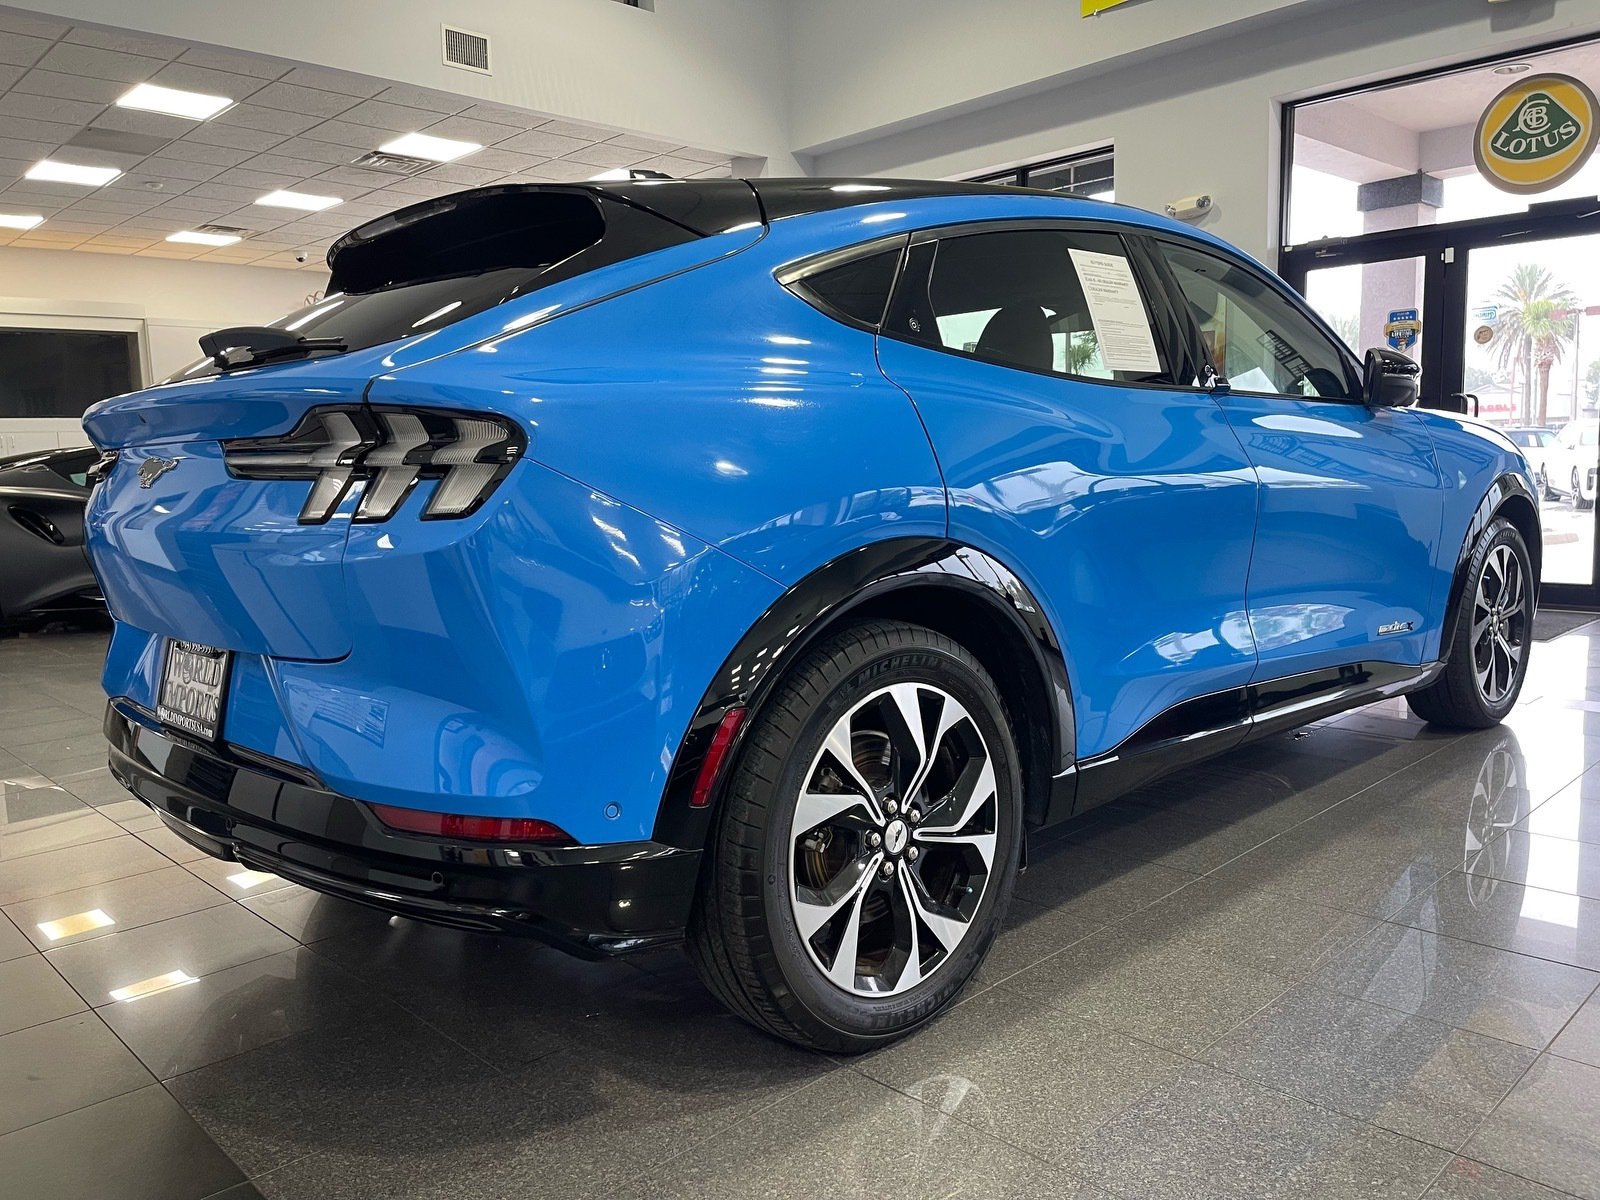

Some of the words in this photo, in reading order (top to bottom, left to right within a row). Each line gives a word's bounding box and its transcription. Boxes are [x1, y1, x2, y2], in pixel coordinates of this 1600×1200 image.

[1493, 120, 1577, 155] LOTUS
[173, 649, 223, 687] WORLD
[858, 654, 939, 689] MICHELIN
[164, 681, 219, 723] IMPORTS
